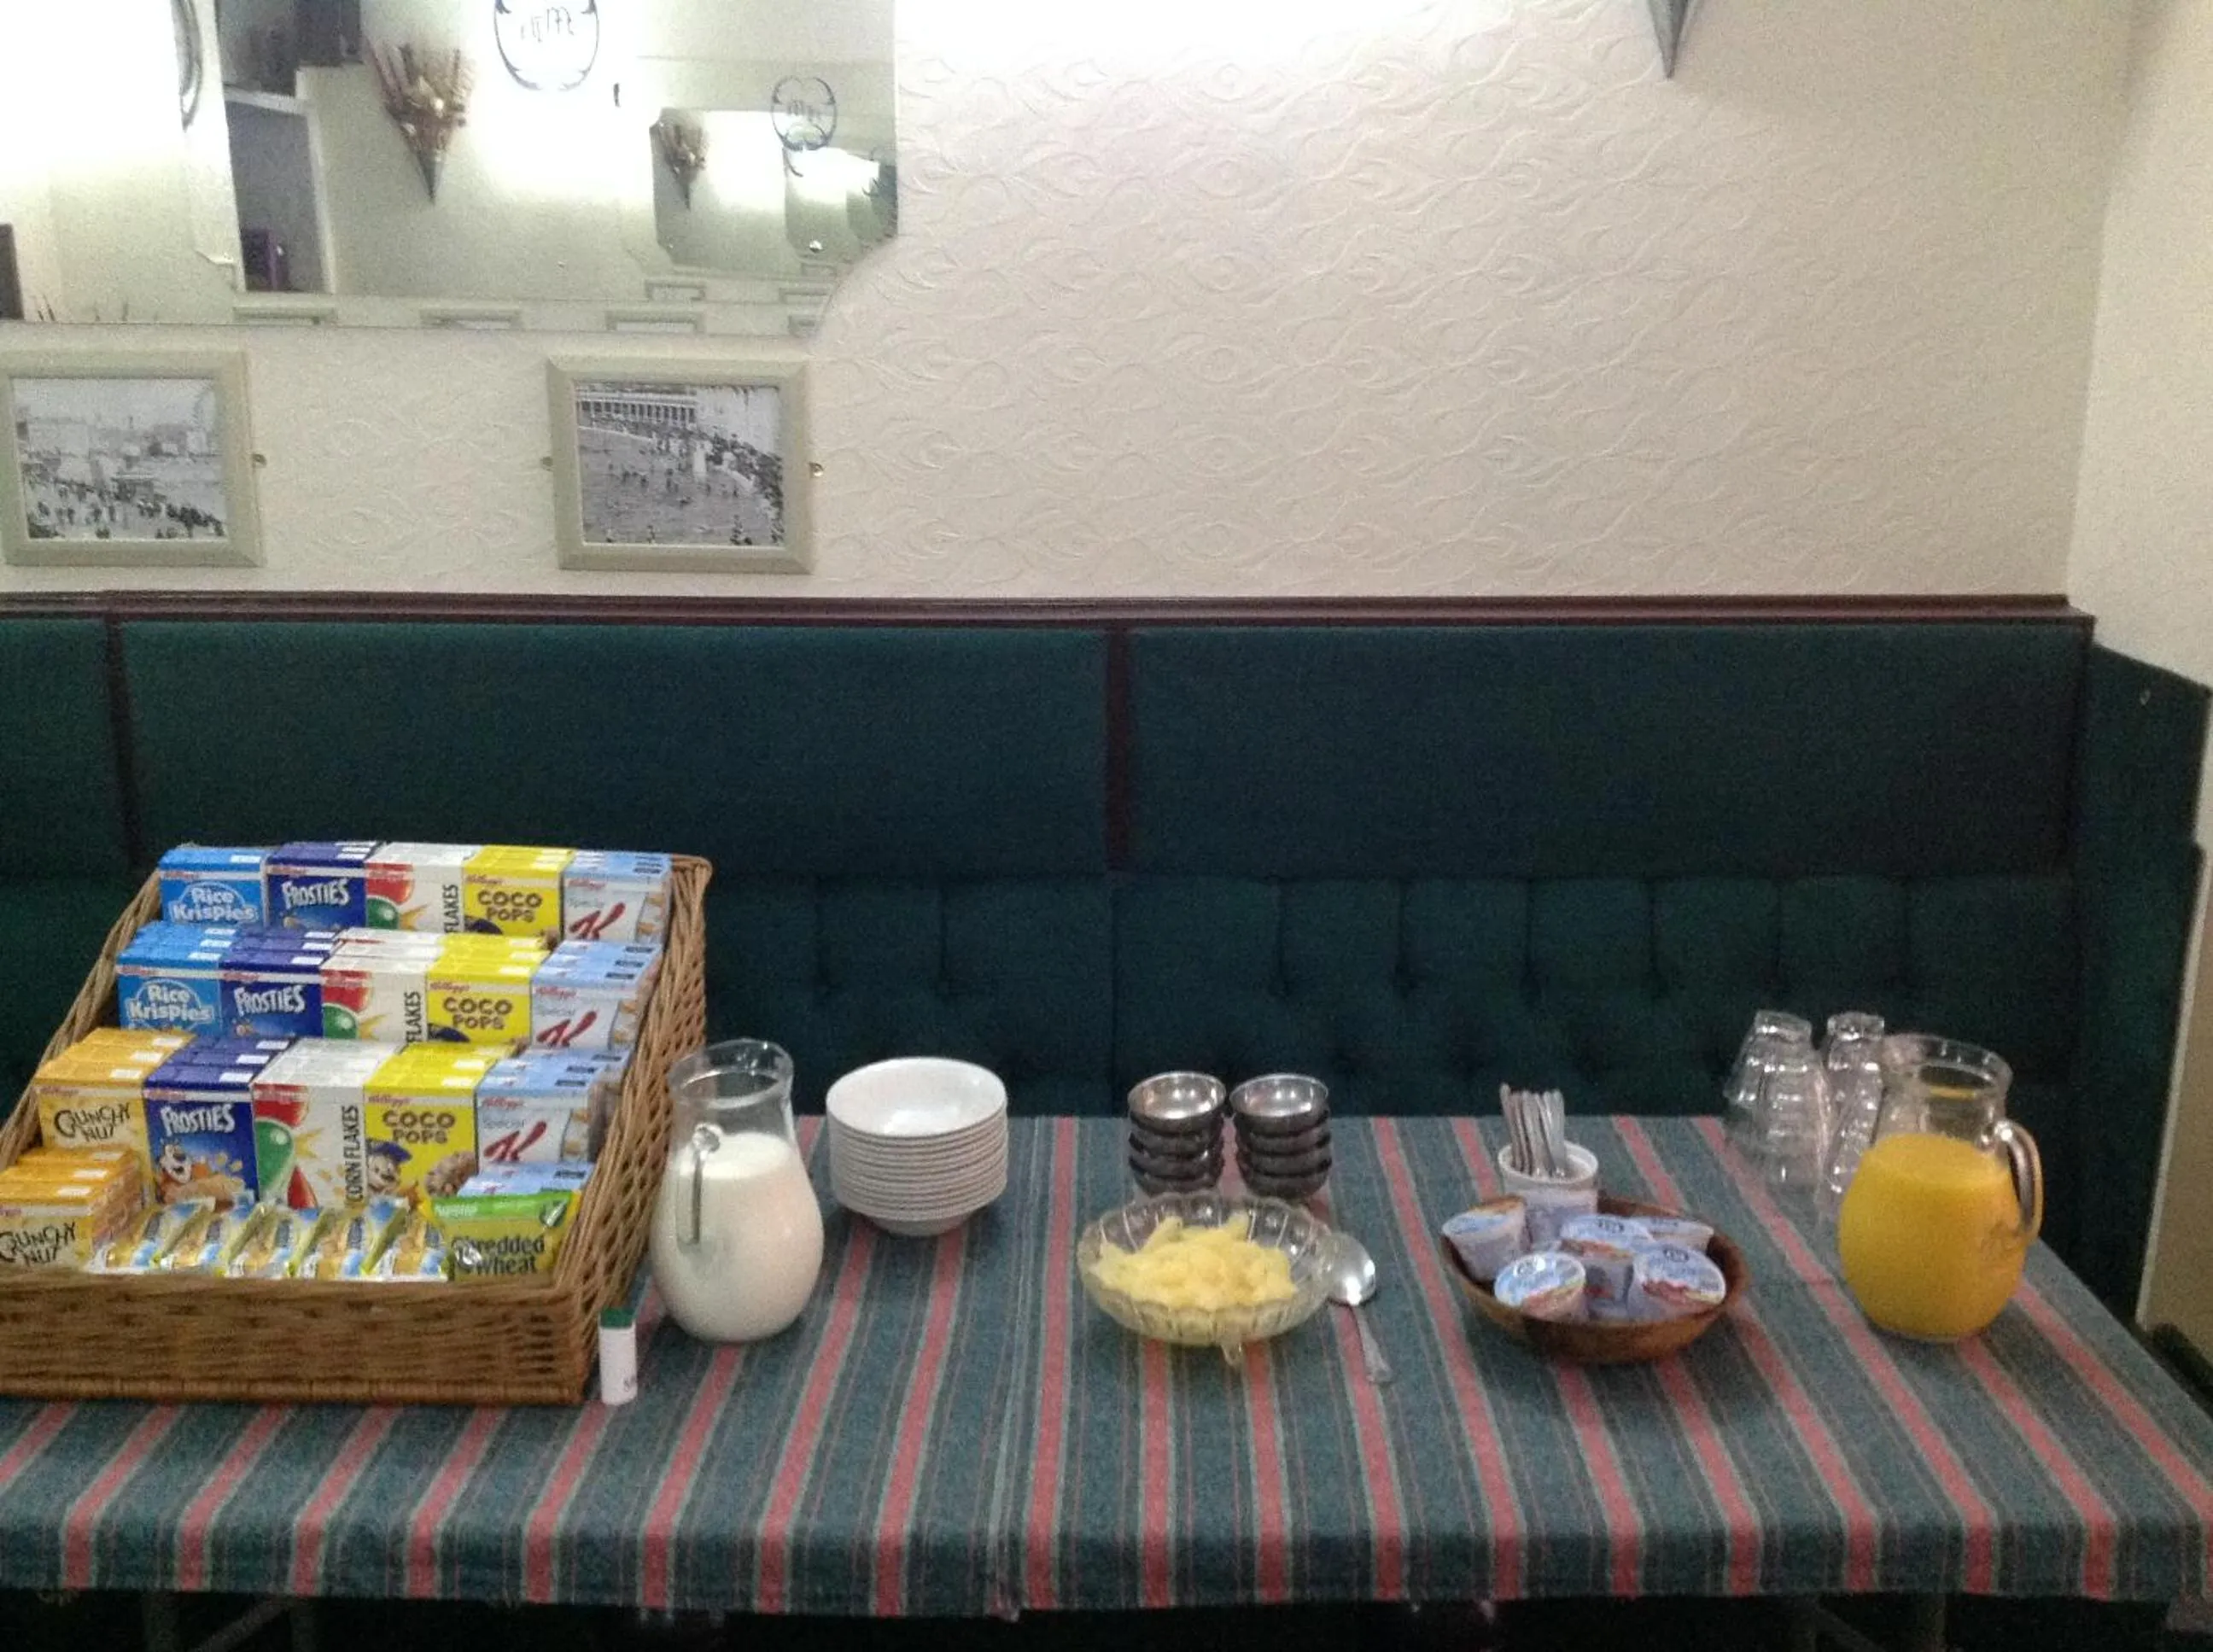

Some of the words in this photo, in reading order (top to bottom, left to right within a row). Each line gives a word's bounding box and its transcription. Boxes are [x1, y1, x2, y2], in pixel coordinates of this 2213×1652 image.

[190, 886, 235, 904] Rice
[281, 878, 350, 909] FROSTIES
[476, 890, 543, 908] COCO
[172, 902, 257, 922] Krispies
[441, 884, 458, 934] FLAKES
[486, 907, 536, 923] POPS
[146, 983, 191, 1003] Rice
[232, 984, 306, 1016] FROSTIES
[128, 998, 213, 1022] Krispies
[442, 996, 513, 1015] COCO
[404, 990, 422, 1044] FLAKES
[452, 1014, 505, 1030] POPS
[160, 1102, 236, 1137] FROSTIES
[382, 1110, 456, 1129] COCO
[342, 1105, 360, 1164] FLAKES
[392, 1128, 449, 1145] POPS
[345, 1164, 364, 1204] CORN
